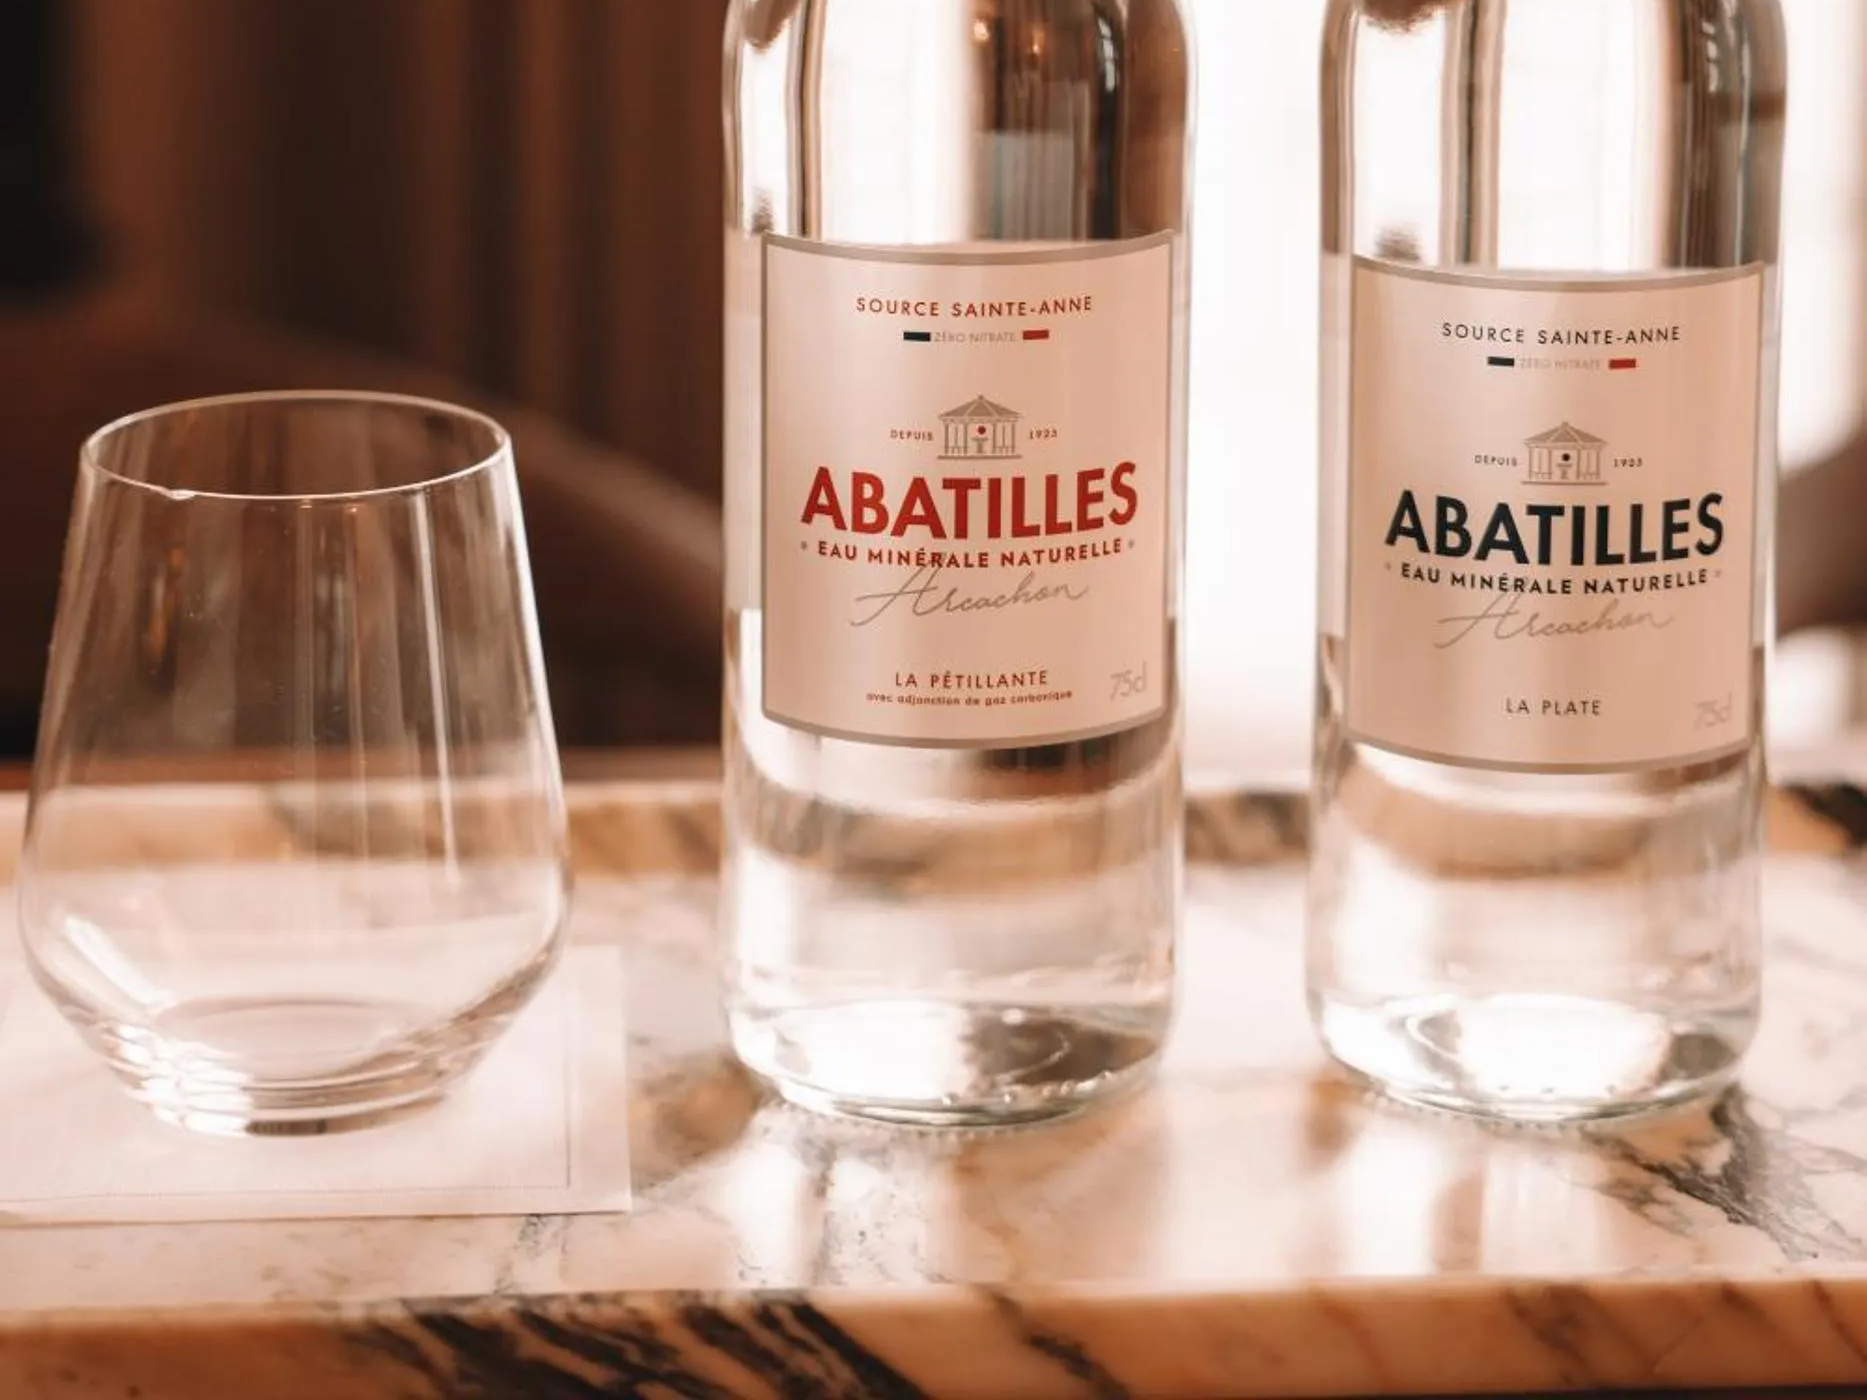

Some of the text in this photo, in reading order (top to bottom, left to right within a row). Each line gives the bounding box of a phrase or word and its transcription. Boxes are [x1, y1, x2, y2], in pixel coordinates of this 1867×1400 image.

[856, 296, 1092, 318] SOURCE SAINTE-ANNE
[1442, 322, 1680, 345] SOURCE SAINTE-ANNE
[890, 428, 1058, 441] DEPUIS 1923
[1474, 454, 1518, 467] DEPUIS
[800, 461, 1138, 540] ABATILLES
[1385, 489, 1724, 567] ABATILLES
[818, 538, 1122, 569] EAU MINÉRALE NATURELLE
[1401, 562, 1707, 595] EAU MINÉRALE NATURELLE
[850, 560, 1090, 626] Arcachon
[1433, 585, 1675, 649] Arcachon
[895, 669, 1048, 690] LA PÉTILLANTE
[1110, 661, 1147, 701] 75cl
[866, 692, 893, 703] avec
[897, 692, 961, 707] adjonction
[965, 696, 979, 706] de
[985, 696, 1006, 707] gaz
[1505, 698, 1601, 716] LA PLATE
